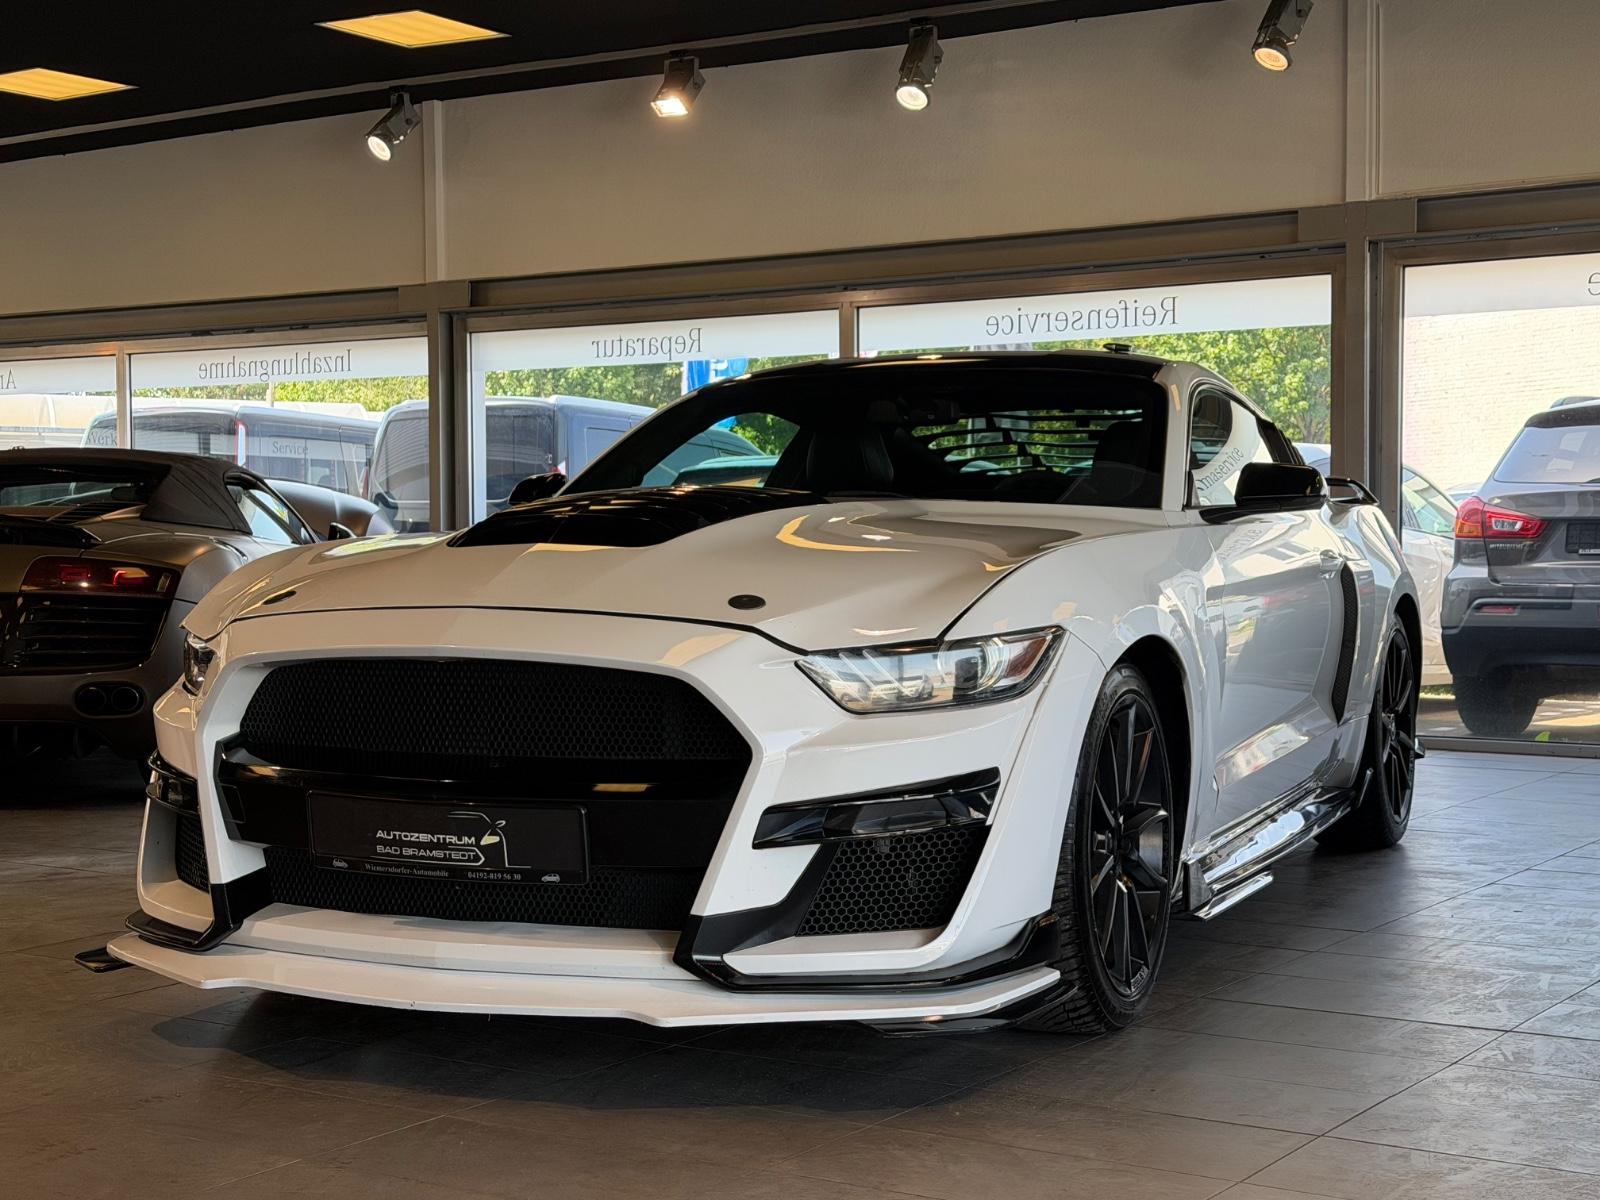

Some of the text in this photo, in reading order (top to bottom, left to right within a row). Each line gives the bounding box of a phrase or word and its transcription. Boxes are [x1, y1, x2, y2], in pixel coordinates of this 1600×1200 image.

[376, 830, 476, 845] AUTOZENTRUM
[376, 845, 477, 860] BAD BRAMSTEDT
